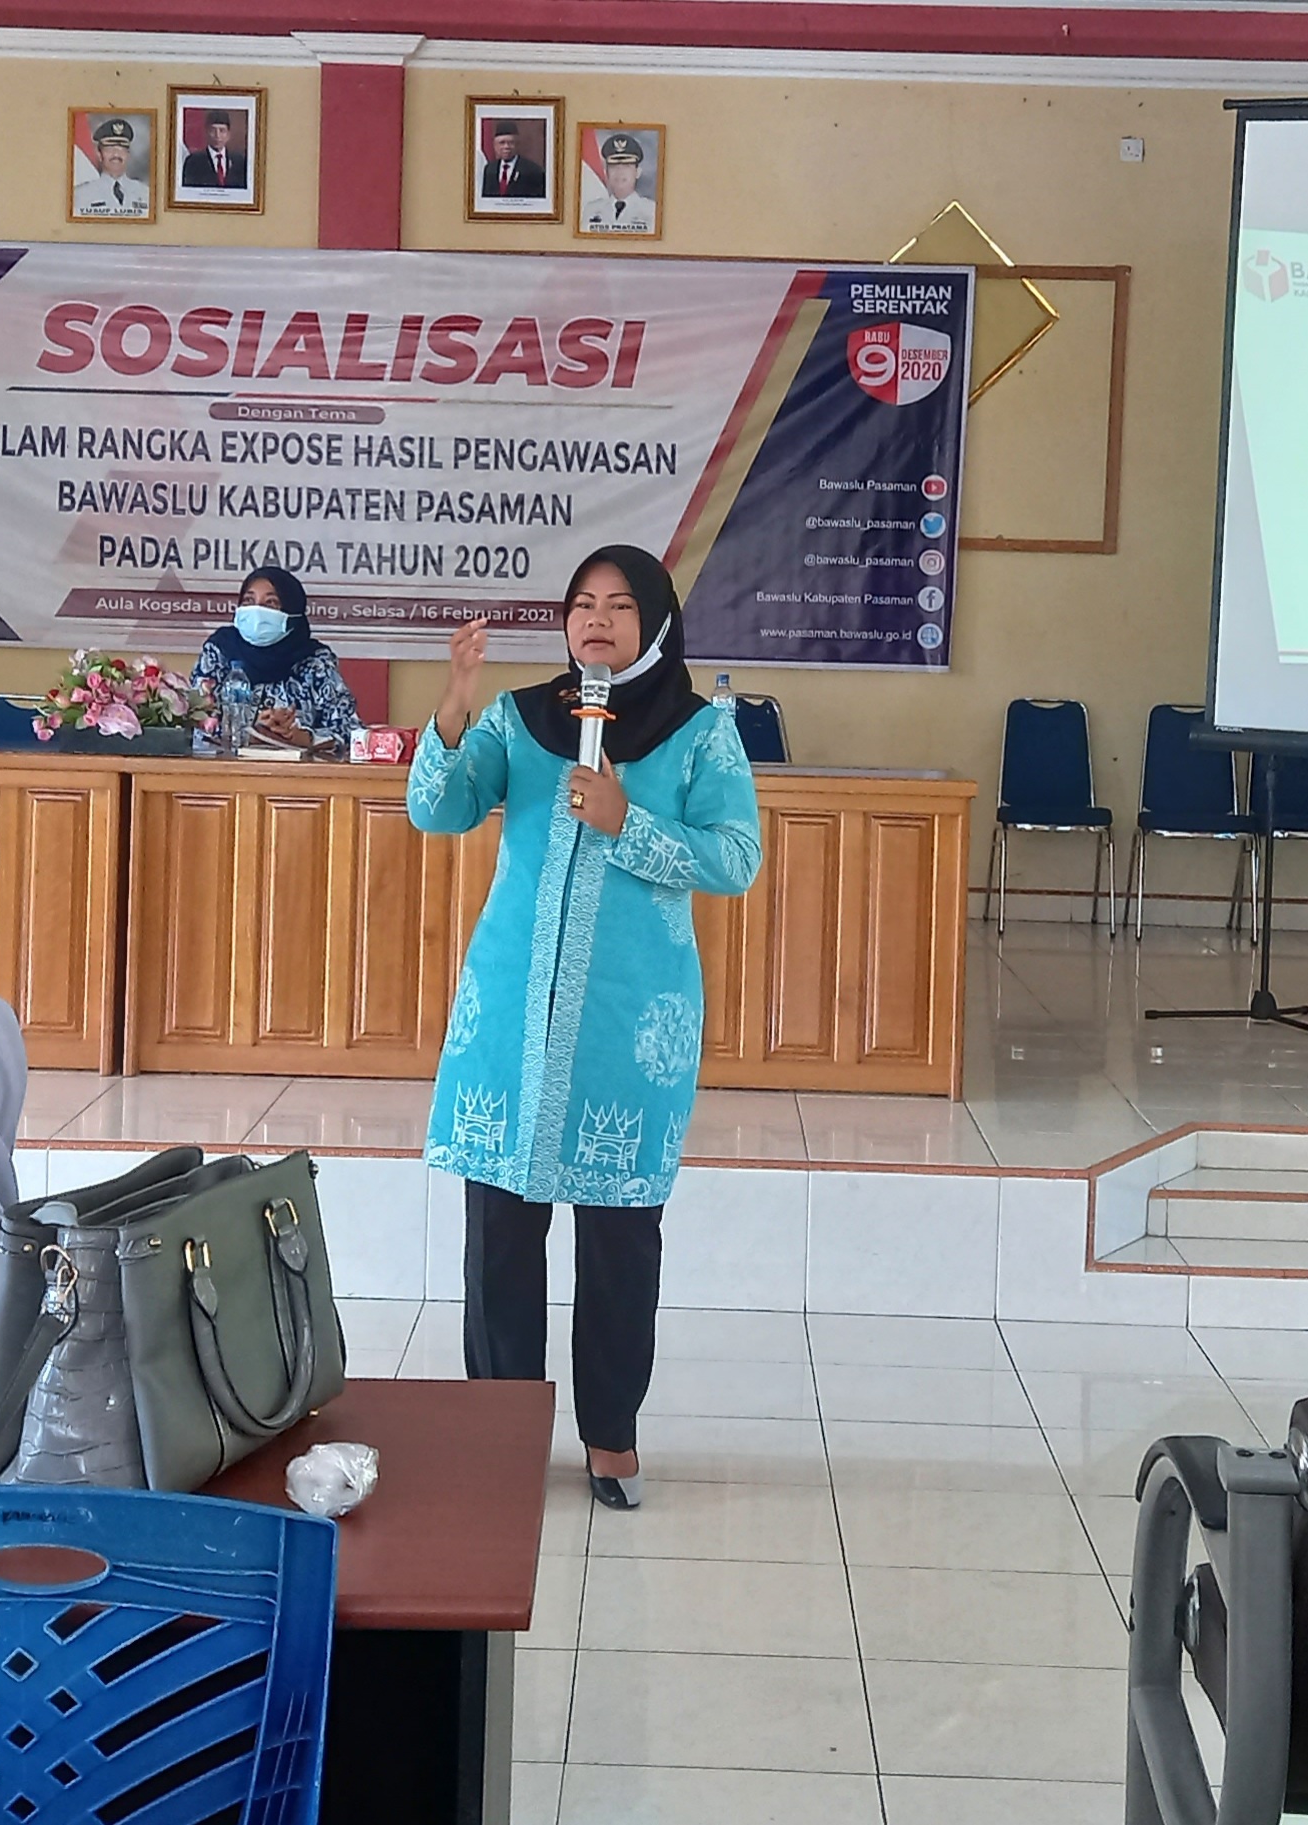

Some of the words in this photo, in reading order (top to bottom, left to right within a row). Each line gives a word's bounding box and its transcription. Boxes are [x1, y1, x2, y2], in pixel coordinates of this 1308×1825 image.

[851, 284, 952, 300] PEMILIHAN
[852, 300, 949, 315] SERENTAK
[864, 331, 890, 343] RABU
[35, 301, 647, 389] SOSIALISASI
[901, 349, 948, 361] DESEMBER
[856, 344, 896, 386] 9
[901, 361, 942, 381] 2020
[238, 406, 303, 420] Dengan
[308, 408, 356, 420] Tema
[78, 426, 211, 462] RANGKA
[221, 431, 342, 466] EXPOSE
[354, 435, 443, 469] HASIL
[453, 437, 677, 475] PENGAWASAN
[819, 479, 864, 491] Bawaslu
[867, 480, 917, 492] Pasaman
[58, 480, 208, 516] BAWASLU
[219, 484, 405, 521] KABUPATEN
[417, 490, 572, 526] PASAMAN
[805, 516, 916, 531] @bawaslu_pasaman
[99, 535, 183, 569] PADA
[193, 537, 327, 574] PILKADA
[337, 542, 444, 576] TAHUN
[454, 546, 530, 580] 2020
[804, 554, 914, 569] @bawaslu_pasaman
[756, 591, 801, 602] Bawaslu
[804, 592, 861, 605] Kabupaten
[864, 594, 914, 606] Pasaman
[95, 597, 133, 610] Aula
[140, 598, 202, 614] Kogsda
[352, 604, 405, 619] Selasa
[421, 605, 437, 619] 16
[442, 606, 514, 621] Februari
[518, 608, 554, 622] 2021
[760, 627, 912, 642] www.pasaman.bawaslu.go.id
